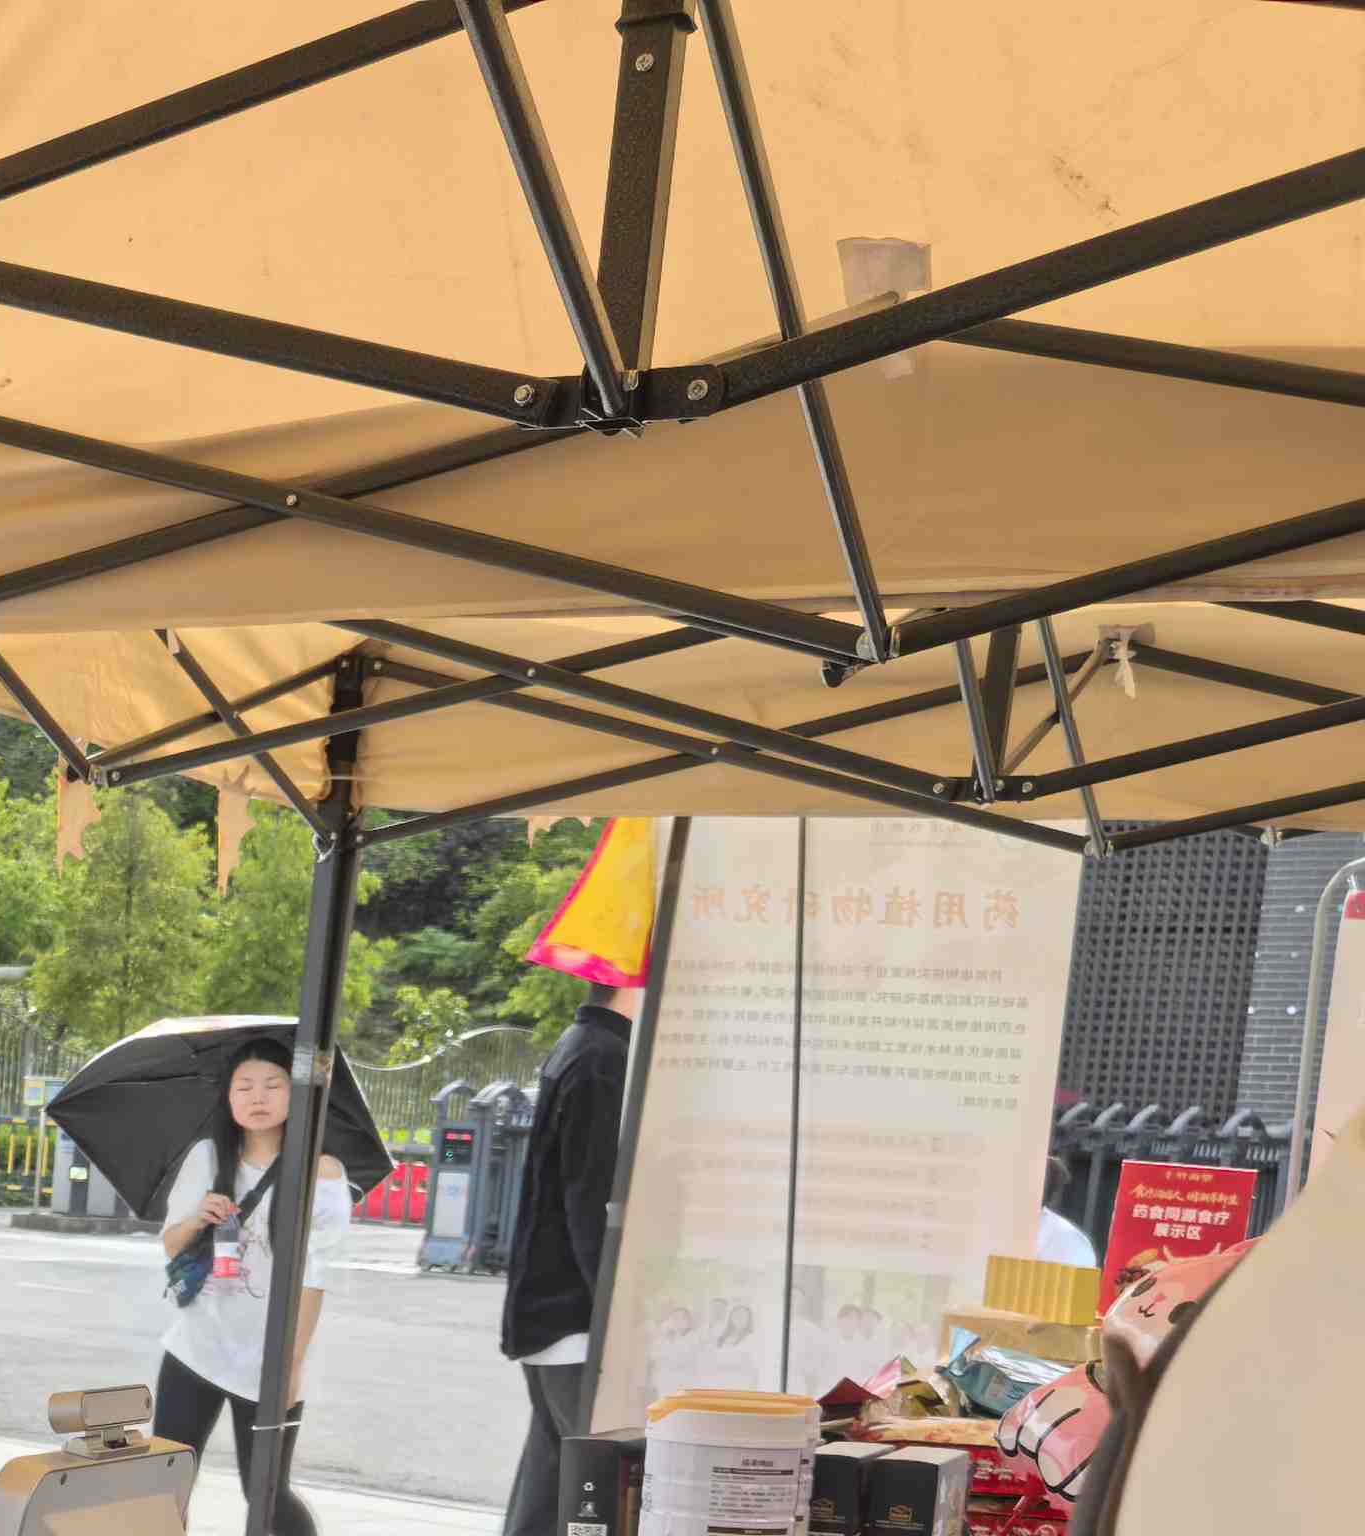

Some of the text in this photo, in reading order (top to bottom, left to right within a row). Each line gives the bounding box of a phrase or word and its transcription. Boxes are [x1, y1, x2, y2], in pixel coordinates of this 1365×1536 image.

[1132, 1204, 1231, 1226] 药食同源食疗
[1153, 1222, 1203, 1241] 展示区
